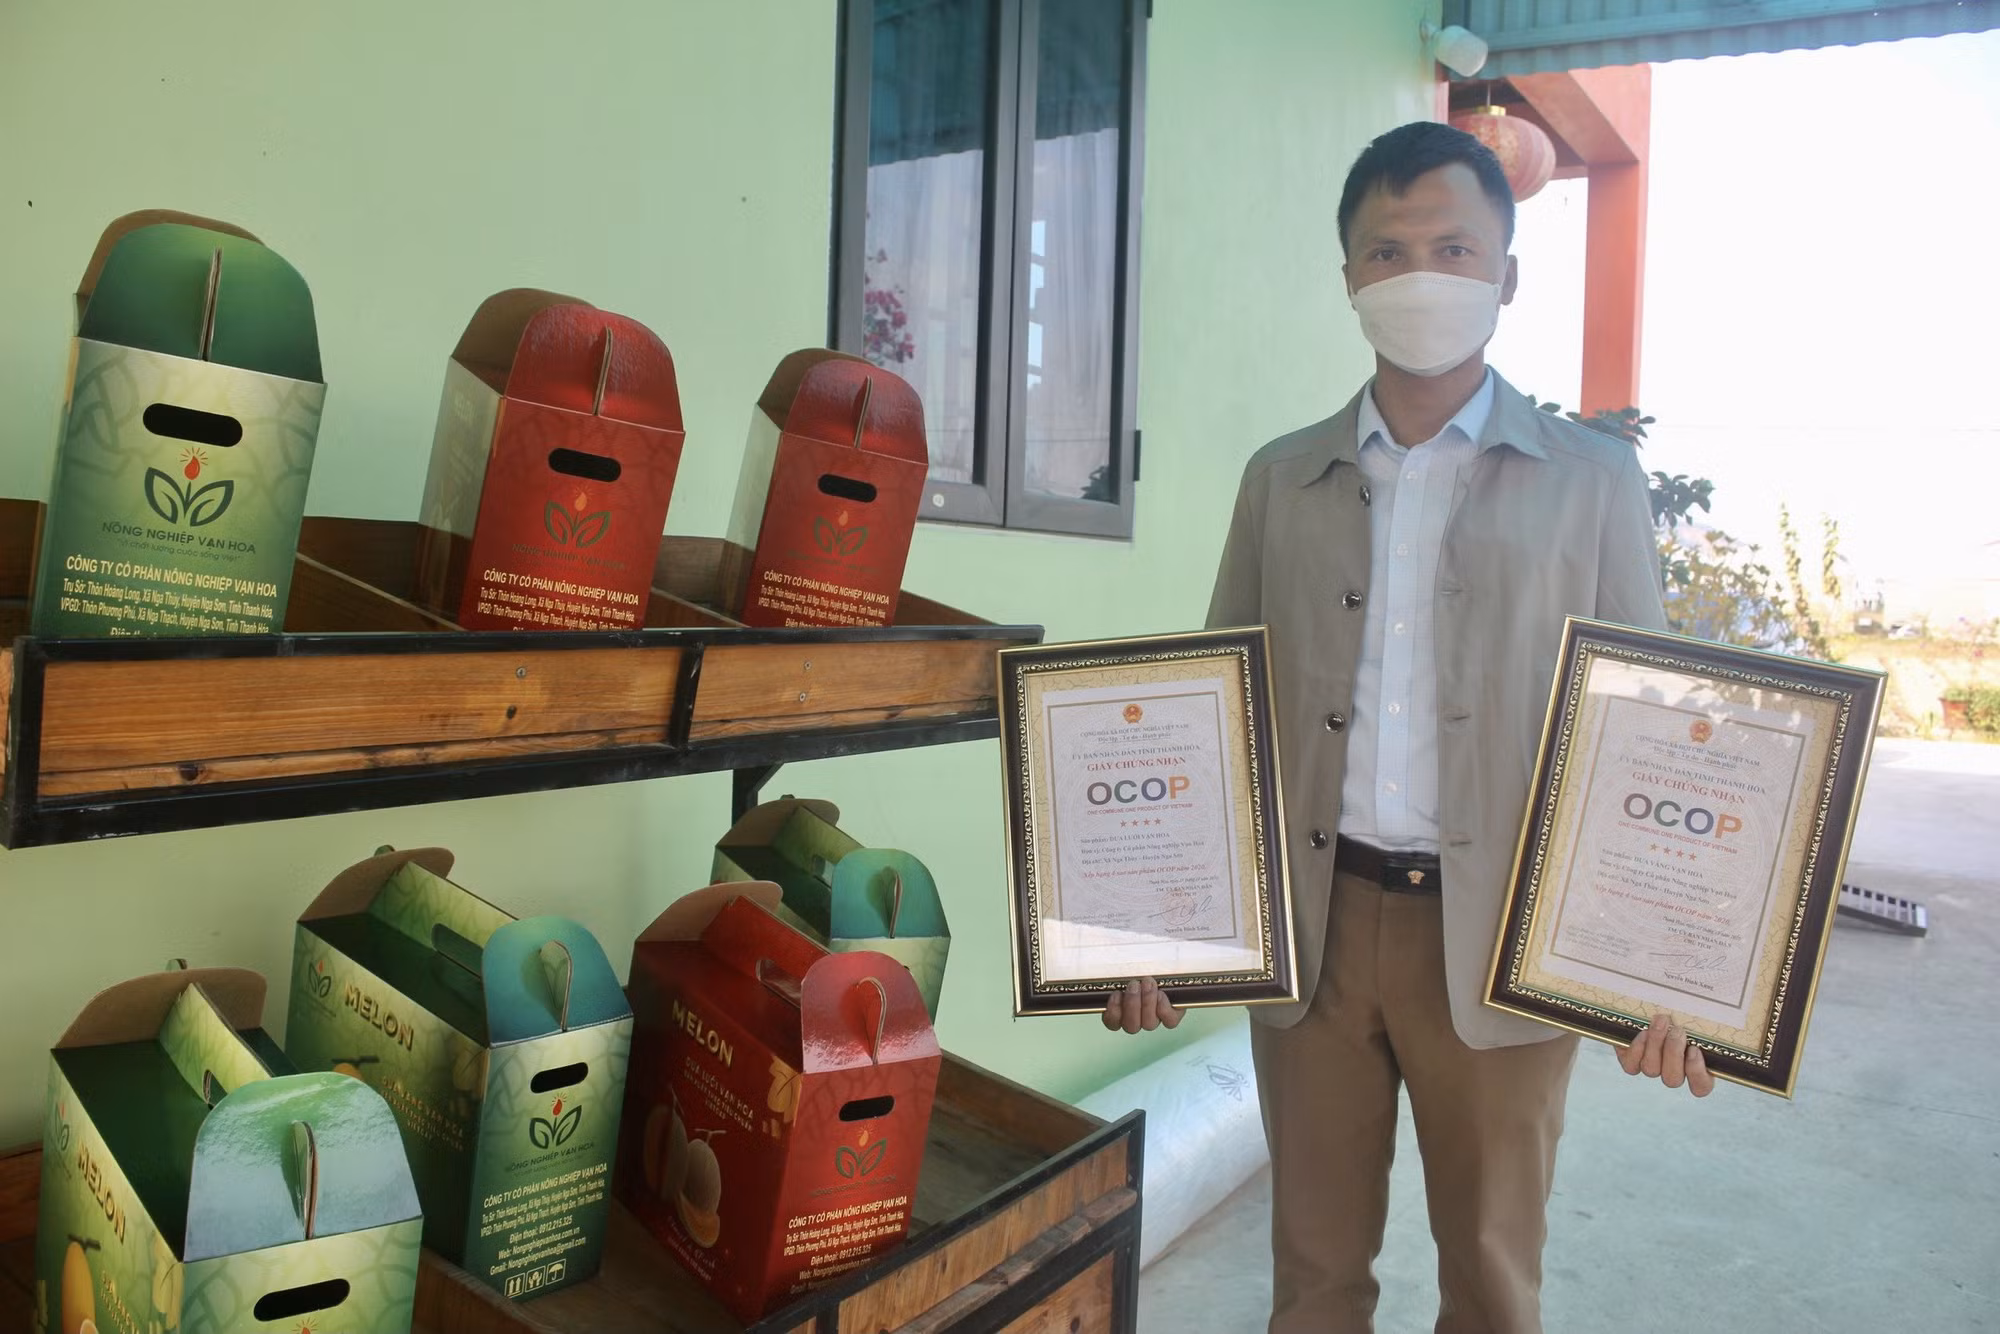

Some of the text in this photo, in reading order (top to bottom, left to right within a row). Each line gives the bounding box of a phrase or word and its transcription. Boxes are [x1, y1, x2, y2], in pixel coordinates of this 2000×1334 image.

[102, 523, 256, 554] NÔNG NGHIỆP VẠN HOA
[67, 555, 98, 574] CÔNG
[100, 561, 114, 576] TY
[163, 567, 192, 586] NÔNG
[195, 573, 231, 593] NGHIỆP
[235, 579, 254, 597] VẠN
[256, 581, 277, 597] HOA
[484, 568, 506, 583] CÔNG
[508, 573, 519, 585] TY
[554, 579, 576, 594] NÔNG
[577, 584, 606, 601] NGHIỆP
[607, 589, 622, 604] VẠN
[623, 591, 639, 604] HOA
[764, 570, 782, 584] CÔNG
[783, 574, 792, 586] TY
[820, 581, 839, 595] NÔNG
[840, 586, 862, 601] NGHIỆP
[863, 590, 876, 604] VẠN
[876, 593, 889, 605] HOA
[1087, 755, 1186, 771] GIẤY CHỨNG NHẬN
[1087, 776, 1190, 805] OCOP
[1632, 771, 1744, 804] GIẤY CHỨNG NHẬN
[1623, 793, 1742, 839] OCOP
[1618, 821, 1630, 829] ONE
[1631, 824, 1660, 836] COMMUNE
[1661, 831, 1673, 839] ONE
[1674, 835, 1701, 846] PRODUCT
[1711, 844, 1737, 854] VIETNAM
[344, 981, 414, 1051] MELON
[672, 999, 734, 1069] MELON
[77, 1142, 126, 1245] MELON
[484, 1194, 502, 1208] CÔNG
[504, 1191, 512, 1202] TY
[540, 1176, 558, 1191] NÔNG
[559, 1170, 581, 1186] NGHIỆP
[582, 1166, 594, 1180] VẠN
[595, 1162, 607, 1174] HOA
[788, 1215, 807, 1229] CÔNG
[808, 1214, 816, 1225] TY
[844, 1204, 860, 1217] NÔNG
[861, 1200, 883, 1215] NGHIỆP
[883, 1198, 895, 1210] VẠN
[896, 1195, 907, 1206] HOA
